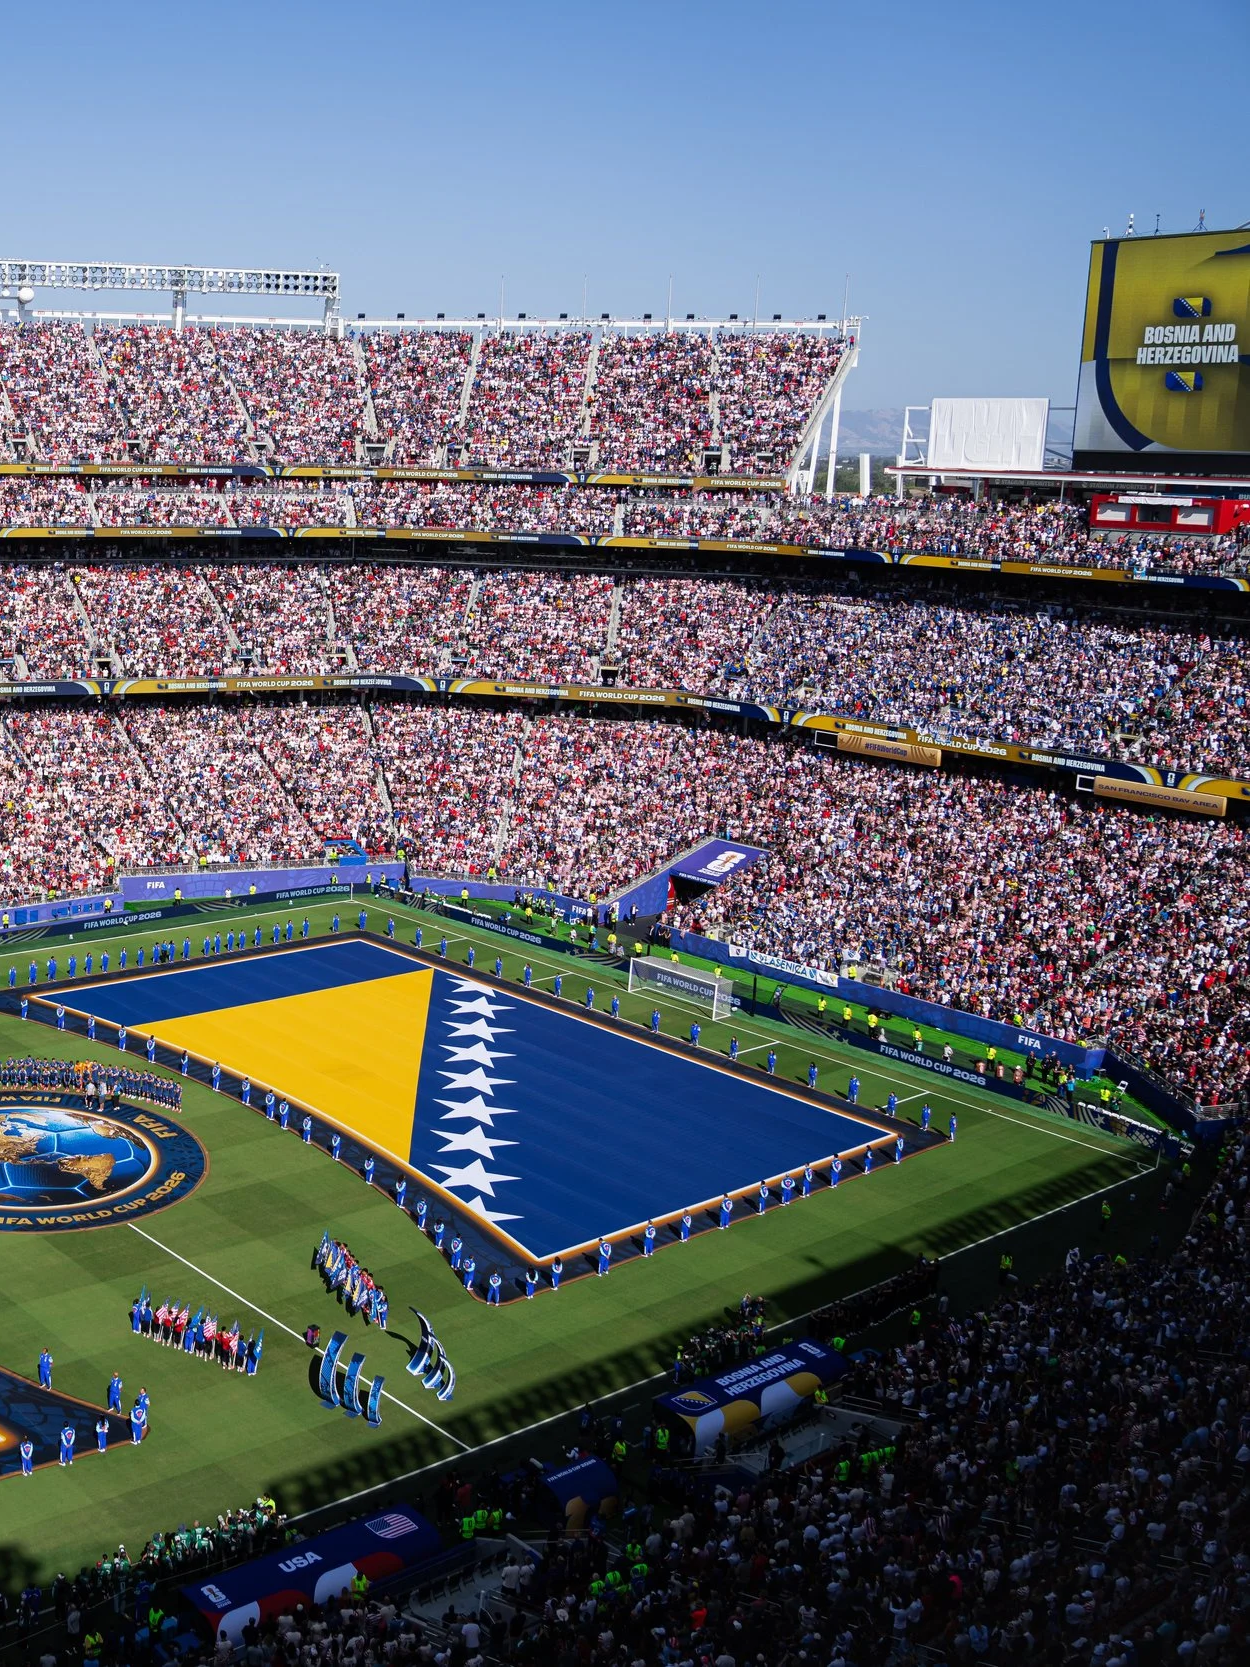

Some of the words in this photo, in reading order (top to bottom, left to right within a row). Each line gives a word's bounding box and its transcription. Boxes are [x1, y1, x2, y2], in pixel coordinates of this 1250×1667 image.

[1144, 325, 1201, 344] BOSNIA
[1202, 324, 1237, 342] AND
[1136, 345, 1239, 365] HERZEGOVINA
[12, 686, 22, 694] AND
[535, 687, 569, 696] HERZEGOVINA
[595, 691, 622, 699] WORLD
[639, 693, 665, 702] 2026
[864, 743, 907, 757] #FIFAWorldCup
[918, 735, 933, 745] FIFA
[963, 742, 978, 752] CUP
[978, 744, 1007, 756] 2026
[1031, 754, 1052, 764] BOSNIA
[1053, 757, 1065, 766] AND
[1066, 759, 1105, 772] HERZEGOVINA
[1098, 784, 1117, 792] SAN
[1119, 787, 1170, 801] FRANCISCO
[1193, 800, 1218, 809] AREA
[276, 891, 291, 899] FIFA
[292, 889, 311, 897] WORLD
[312, 888, 325, 896] CUP
[325, 885, 350, 894] 2026
[84, 920, 99, 929] FIFA
[100, 917, 123, 927] WORLD
[125, 915, 138, 924] CUP
[139, 911, 162, 922] 2026
[572, 905, 587, 915] FIFA
[471, 917, 484, 928] FIFA
[485, 921, 506, 934] WORLD
[507, 927, 519, 938] CUP
[520, 931, 541, 945] 2026
[657, 973, 672, 984] FIFA
[673, 978, 698, 992] WORLD
[699, 986, 714, 997] CUP
[716, 991, 741, 1005] 2026
[1018, 1035, 1041, 1050] FIFA
[880, 1045, 899, 1059] FIFA
[900, 1051, 932, 1069] WORLD
[934, 1061, 952, 1075] CUP
[953, 1067, 986, 1086] 2026
[20, 1095, 61, 1103] FIFA
[132, 1114, 178, 1139] FIFA
[35, 1209, 112, 1224] WORLD
[113, 1199, 147, 1213] CUP
[145, 1171, 186, 1201] 2026
[715, 1364, 760, 1387] BOSNIA
[762, 1354, 787, 1368] AND
[724, 1358, 806, 1397] HERZEGOVINA
[278, 1551, 323, 1573] USA
